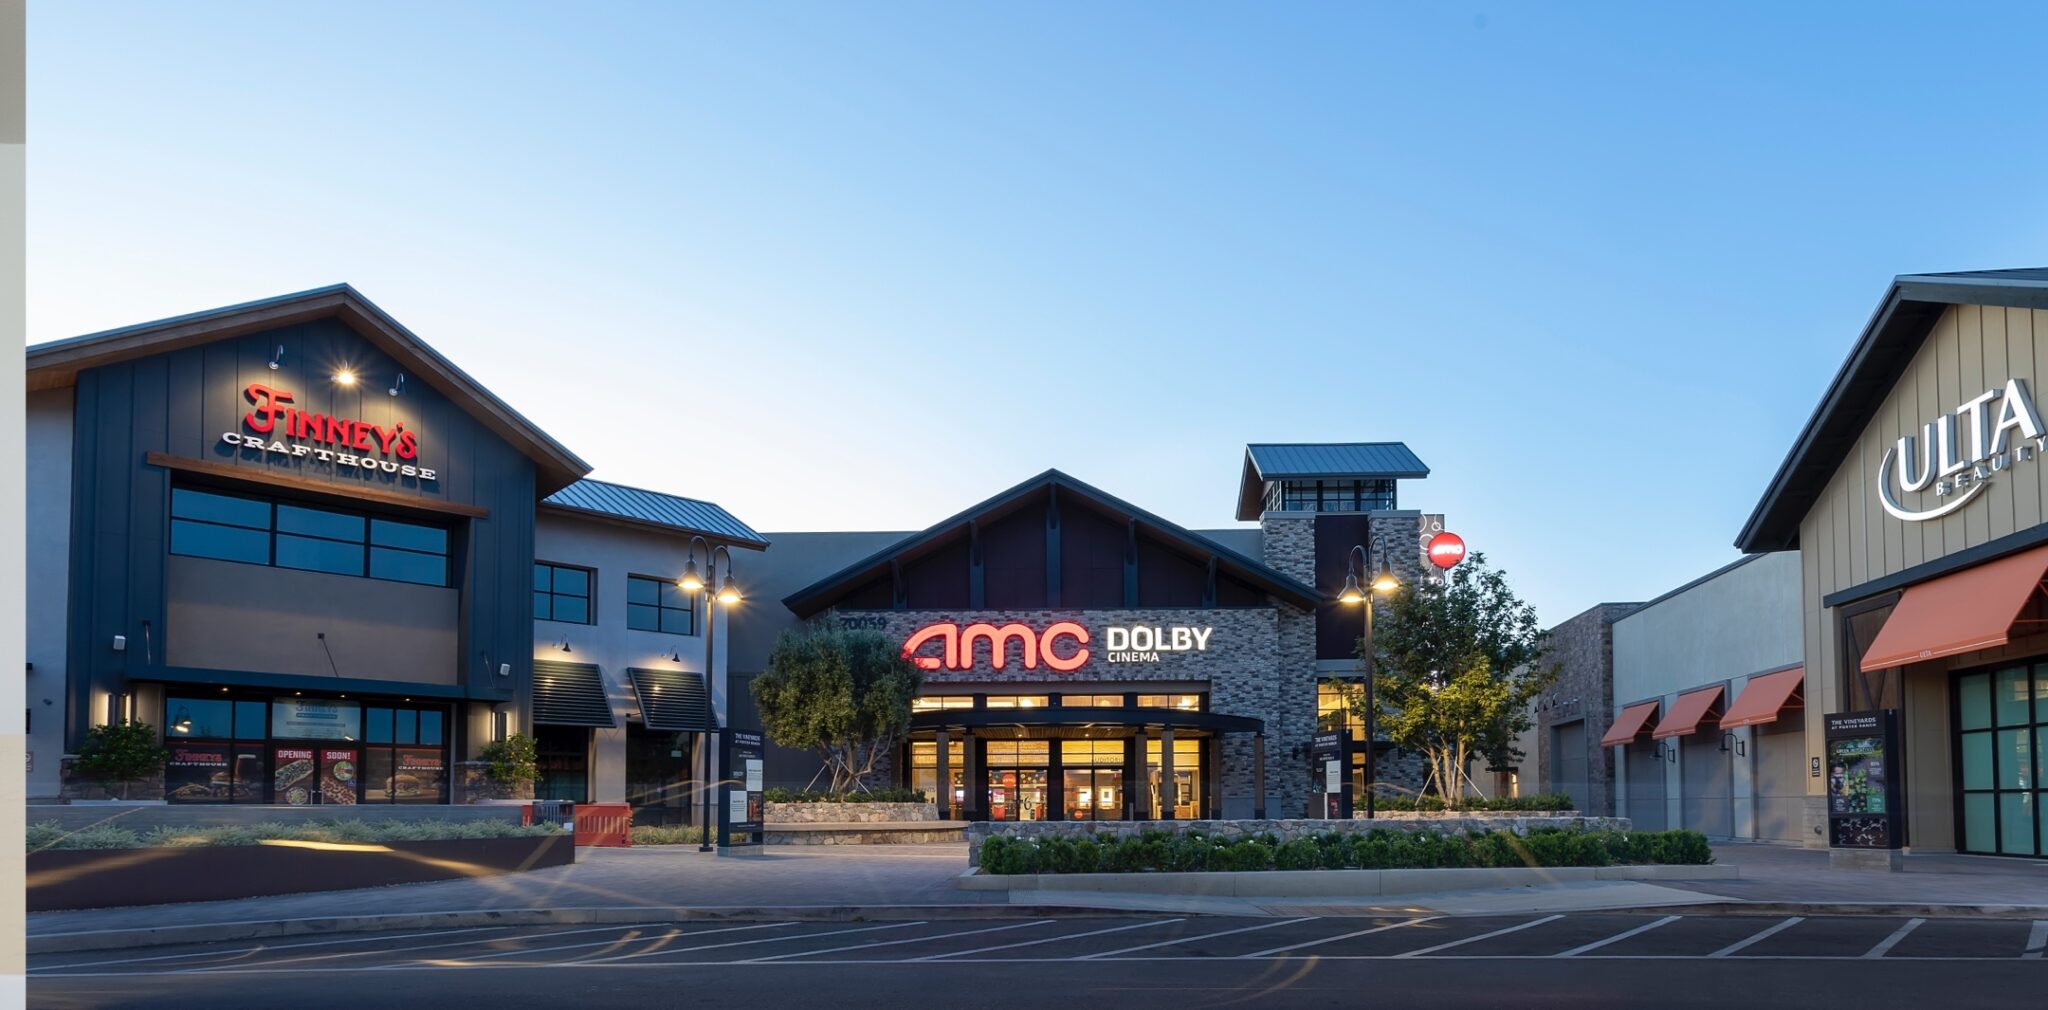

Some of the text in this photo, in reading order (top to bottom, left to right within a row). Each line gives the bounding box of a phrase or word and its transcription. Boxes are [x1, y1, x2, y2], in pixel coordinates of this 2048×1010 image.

[244, 383, 417, 460] FINNEY'S
[1897, 378, 2044, 492] ULTA
[222, 431, 436, 481] CRAFTHOUSE
[1935, 435, 2048, 497] BEAUTY
[1106, 626, 1213, 651] DOLBY
[1107, 651, 1160, 663] CINEMA
[1843, 717, 1876, 725] VINEYARDS
[278, 750, 351, 760] OPENING SOON!
